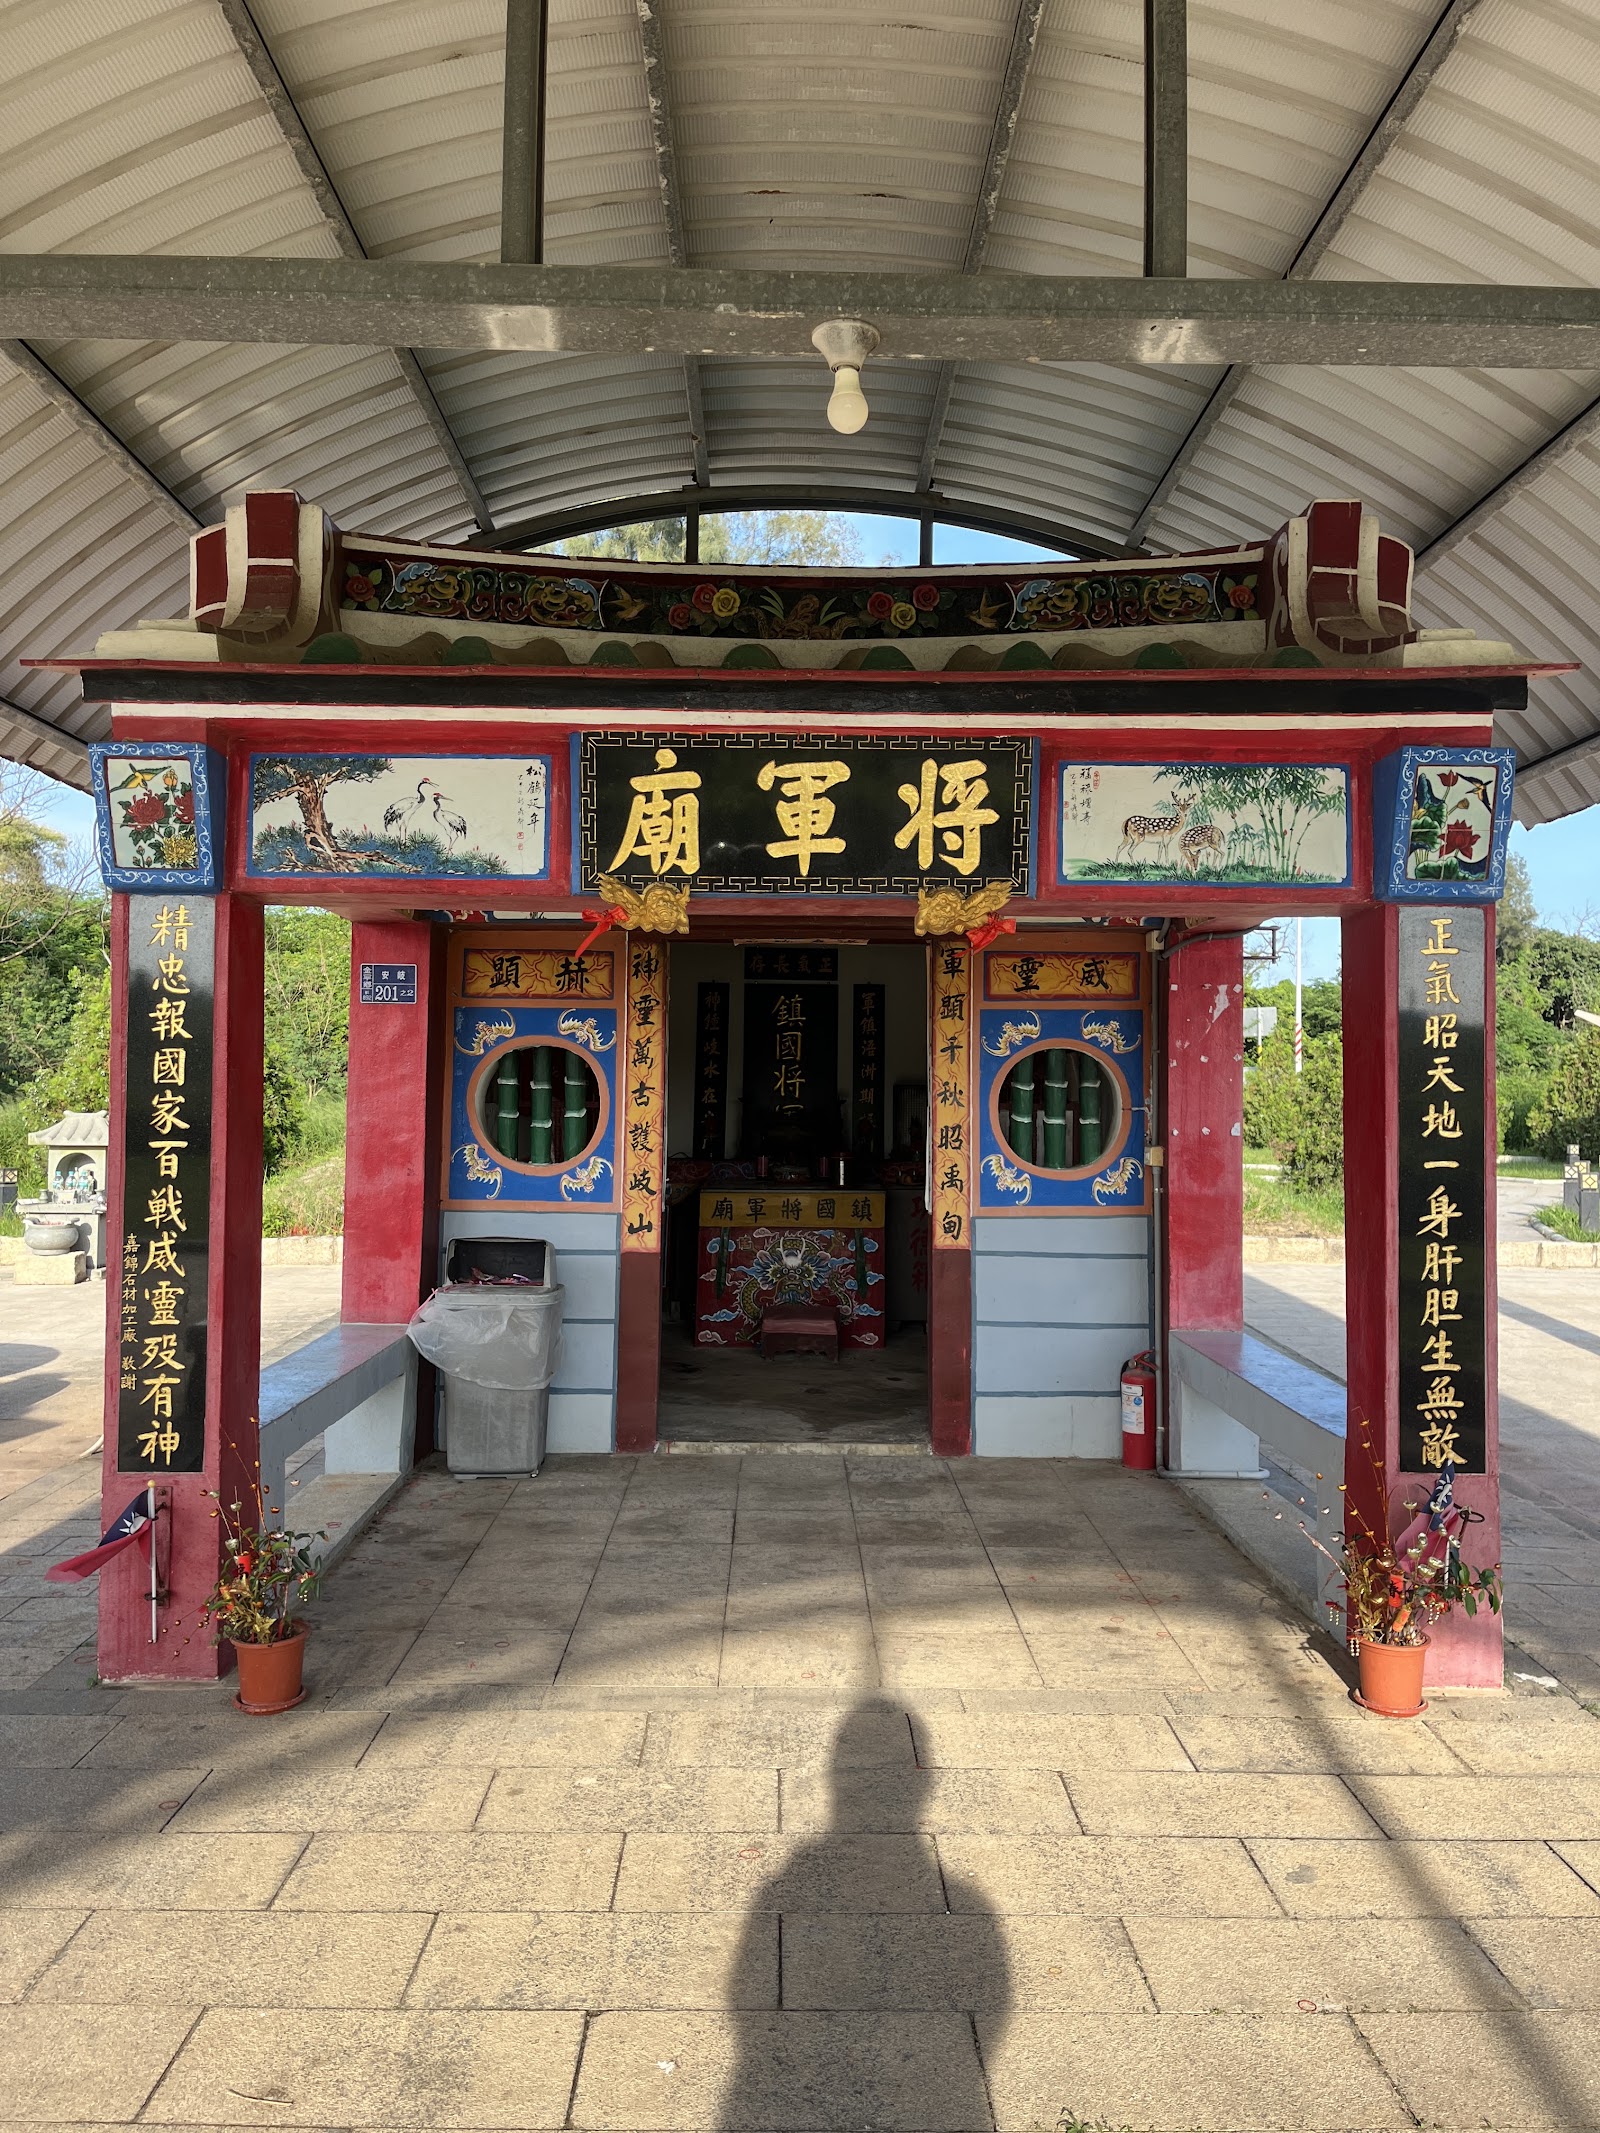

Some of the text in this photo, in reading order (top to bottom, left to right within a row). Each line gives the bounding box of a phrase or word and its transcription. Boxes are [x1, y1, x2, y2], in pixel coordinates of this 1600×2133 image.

[711, 1196, 873, 1223] 鎮國將軍廟
